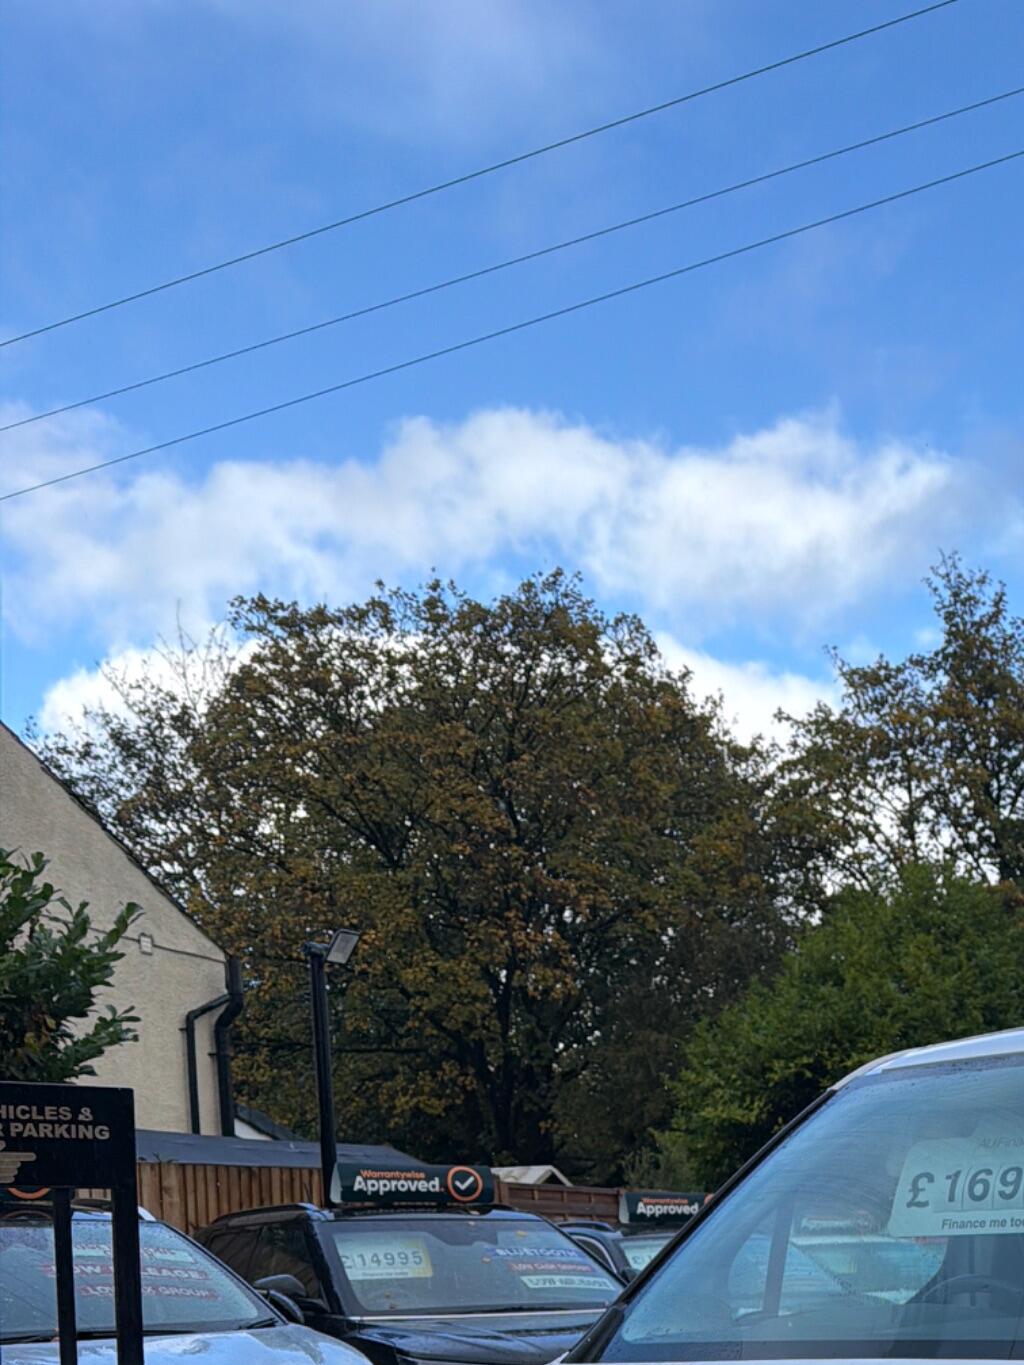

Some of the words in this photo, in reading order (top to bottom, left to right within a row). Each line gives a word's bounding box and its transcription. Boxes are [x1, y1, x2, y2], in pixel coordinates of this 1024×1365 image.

[78, 1107, 93, 1120] &
[10, 1122, 110, 1140] PARKING
[941, 1217, 986, 1230] Finance
[989, 1219, 1007, 1229] me
